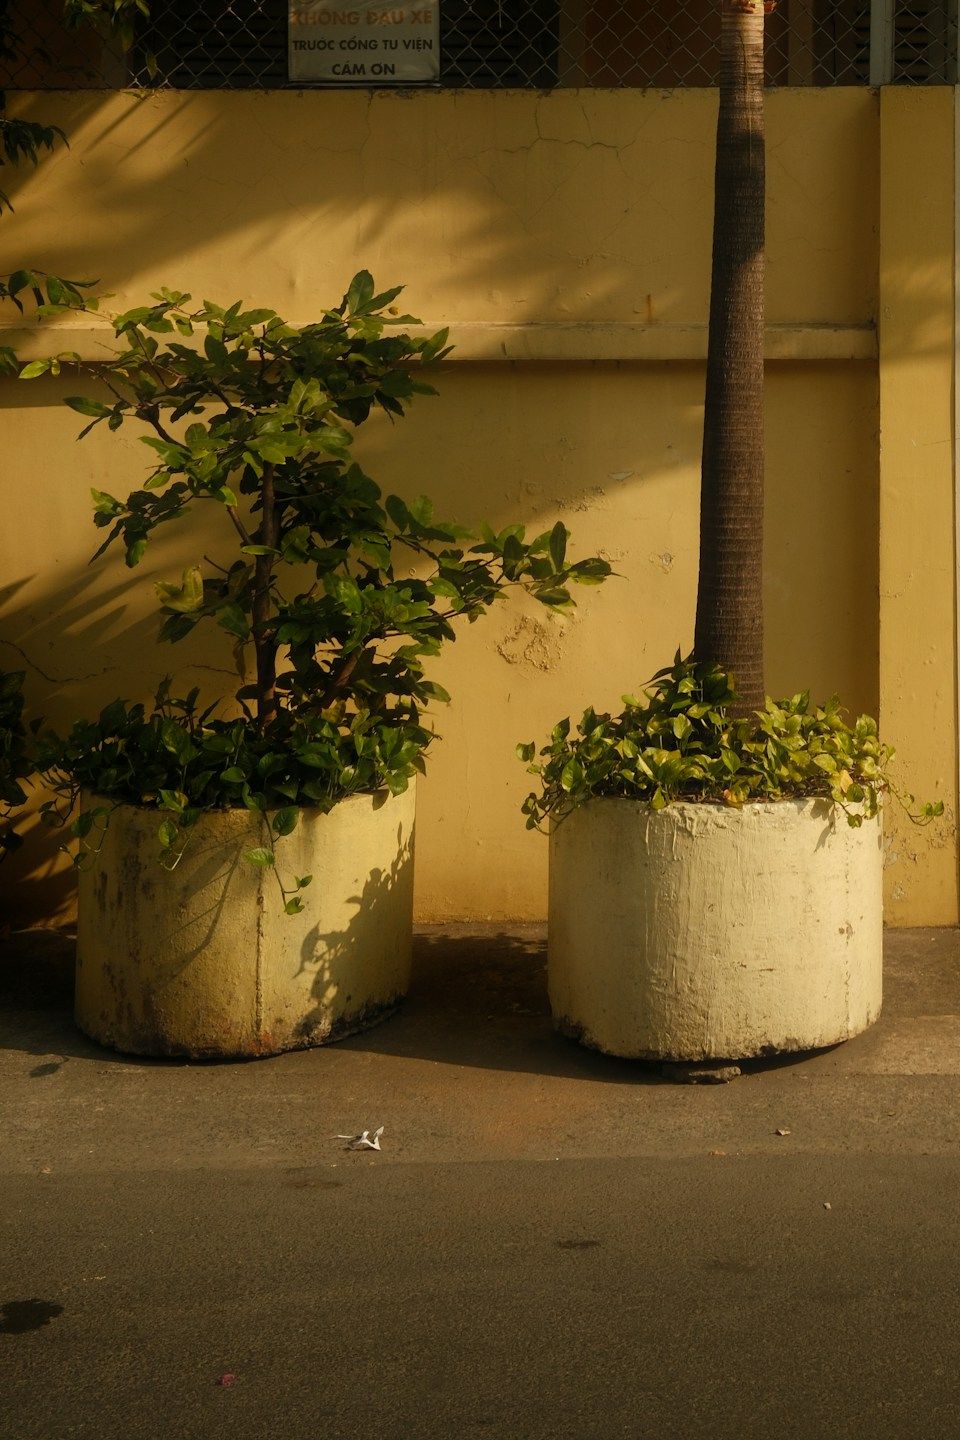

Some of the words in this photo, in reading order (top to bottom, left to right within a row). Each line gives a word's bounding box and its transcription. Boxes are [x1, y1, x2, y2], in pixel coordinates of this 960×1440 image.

[292, 7, 360, 25] KHÔNG
[411, 10, 432, 25] XE
[383, 39, 399, 50] TU
[403, 37, 433, 52] VIỆN
[371, 62, 395, 76] ƠN
